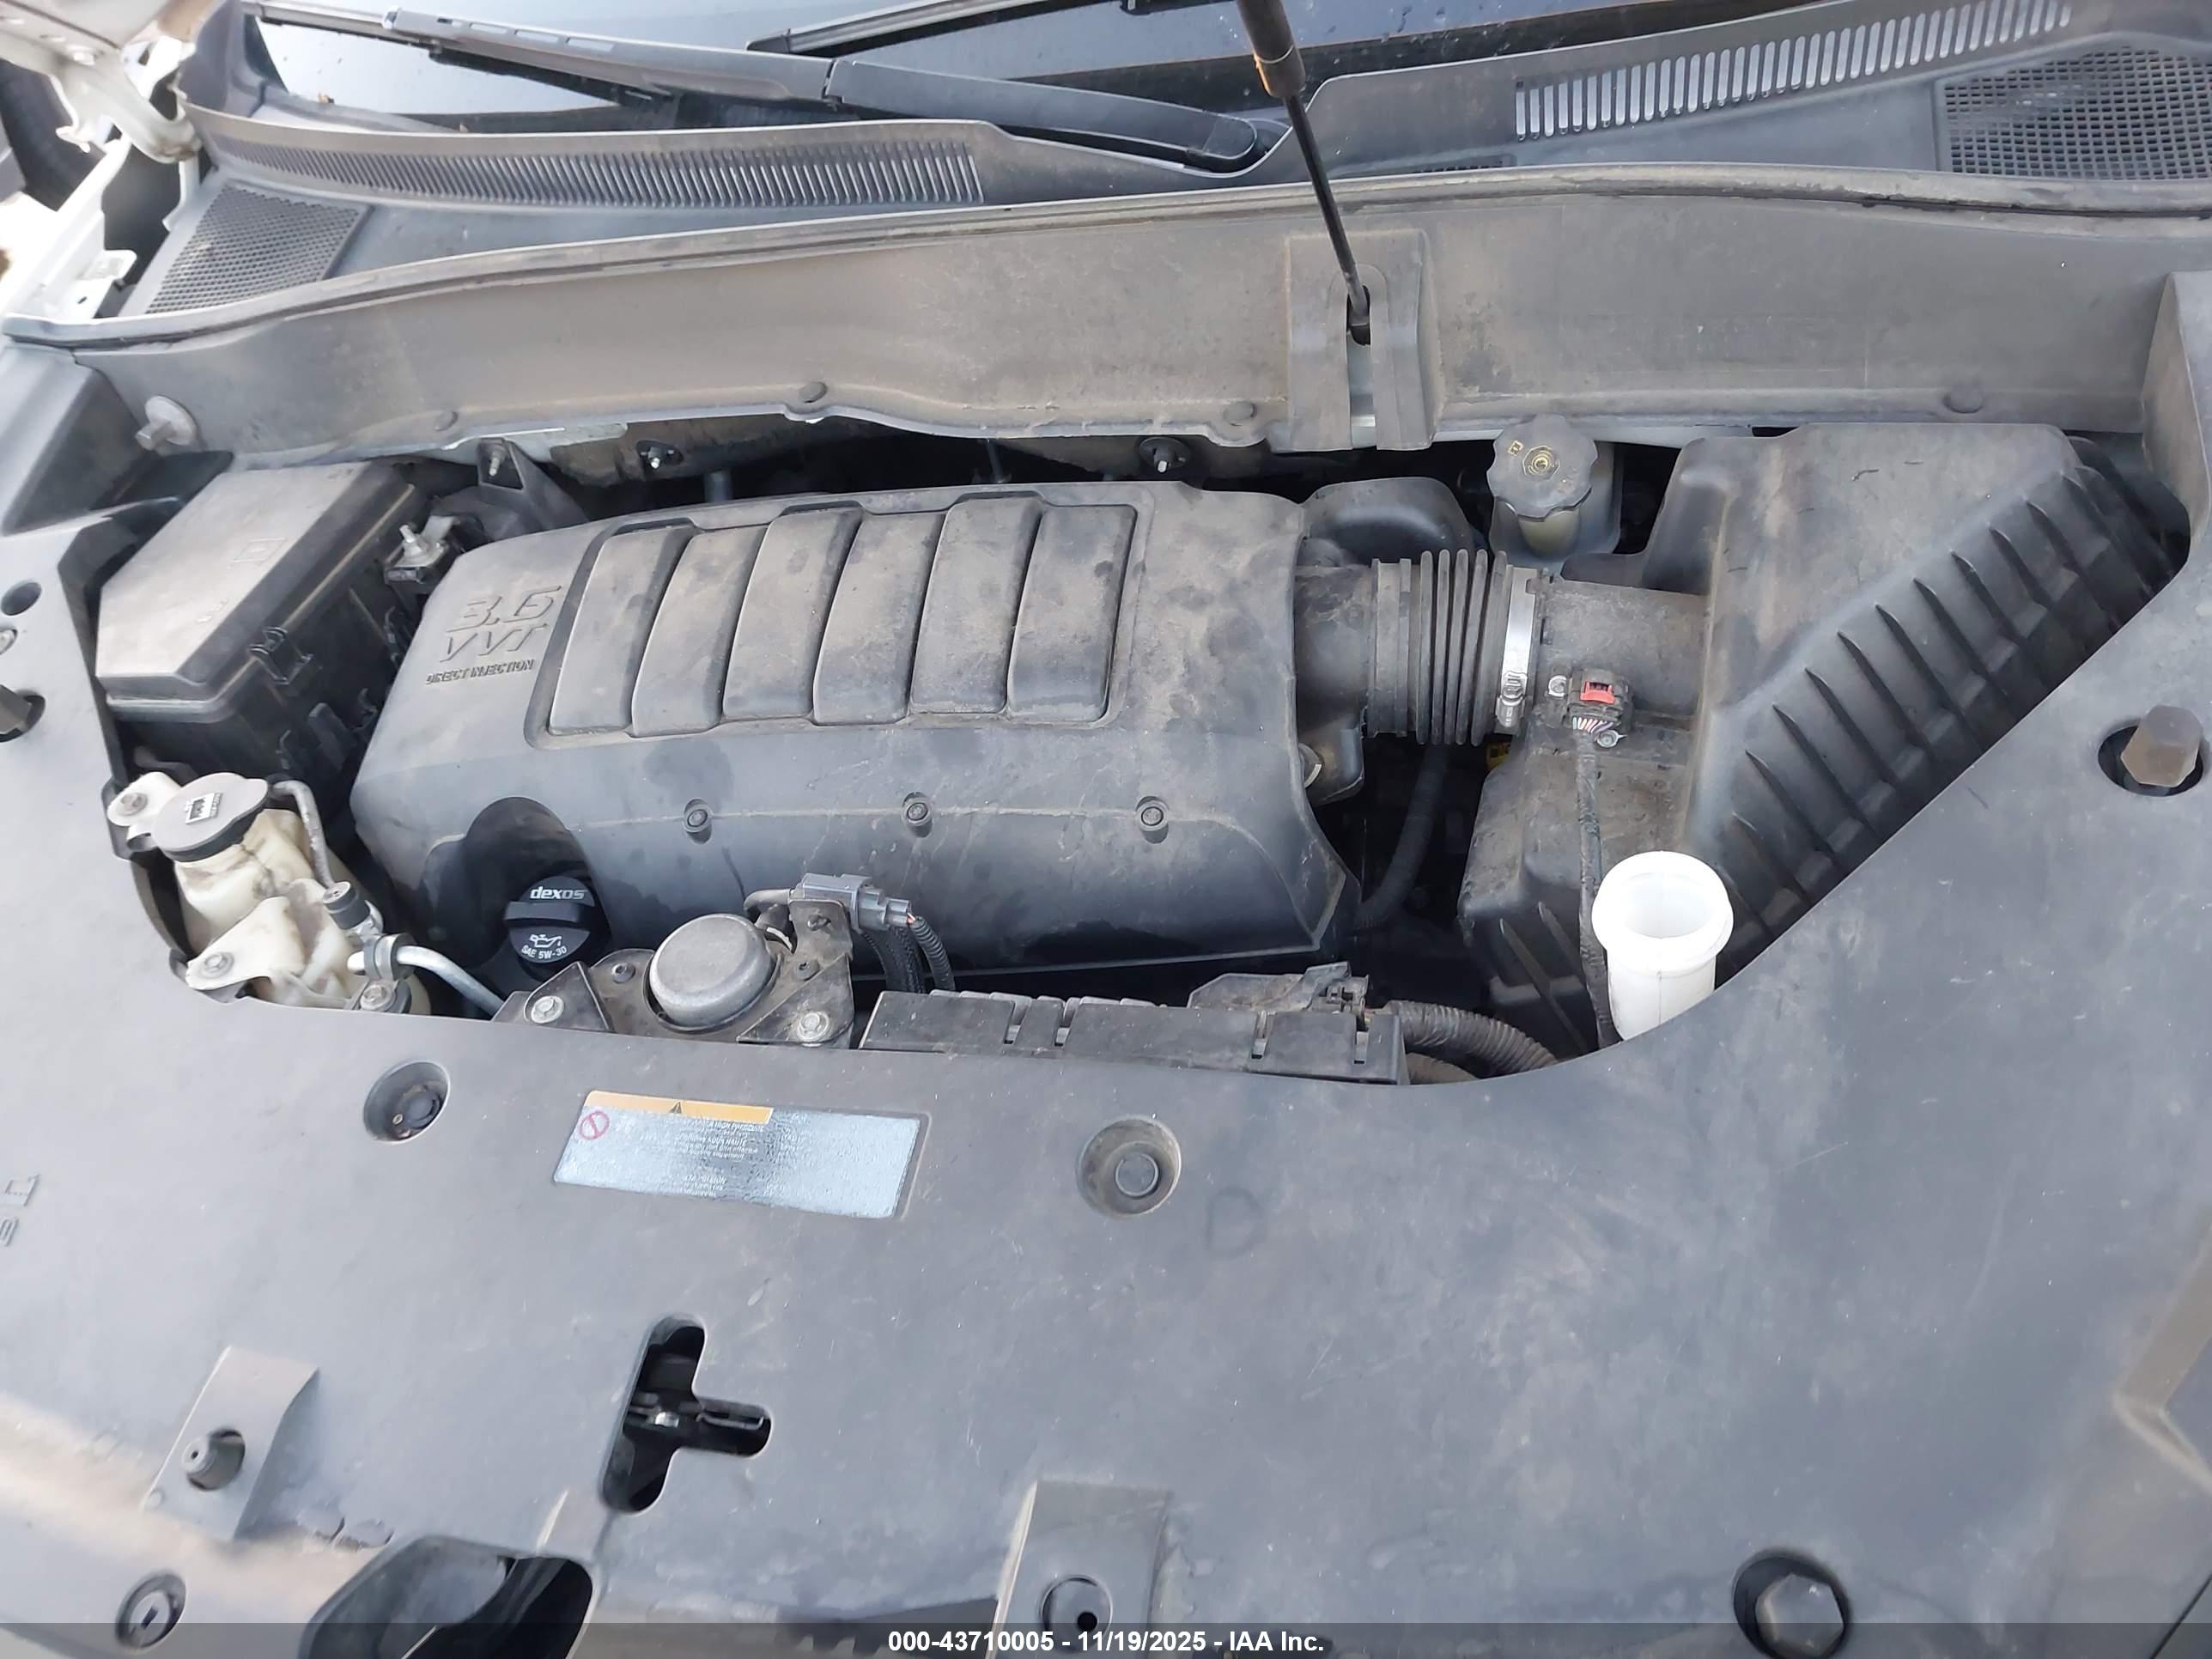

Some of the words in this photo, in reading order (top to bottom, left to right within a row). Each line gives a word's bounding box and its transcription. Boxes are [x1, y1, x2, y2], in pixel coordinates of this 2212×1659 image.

[447, 586, 562, 634] 3.6
[440, 623, 549, 663] VVT
[425, 668, 470, 685] DIRECT
[471, 659, 536, 679] INJECTION
[530, 886, 590, 900] dexos
[520, 945, 538, 958] SAE
[538, 945, 568, 960] 5W-30
